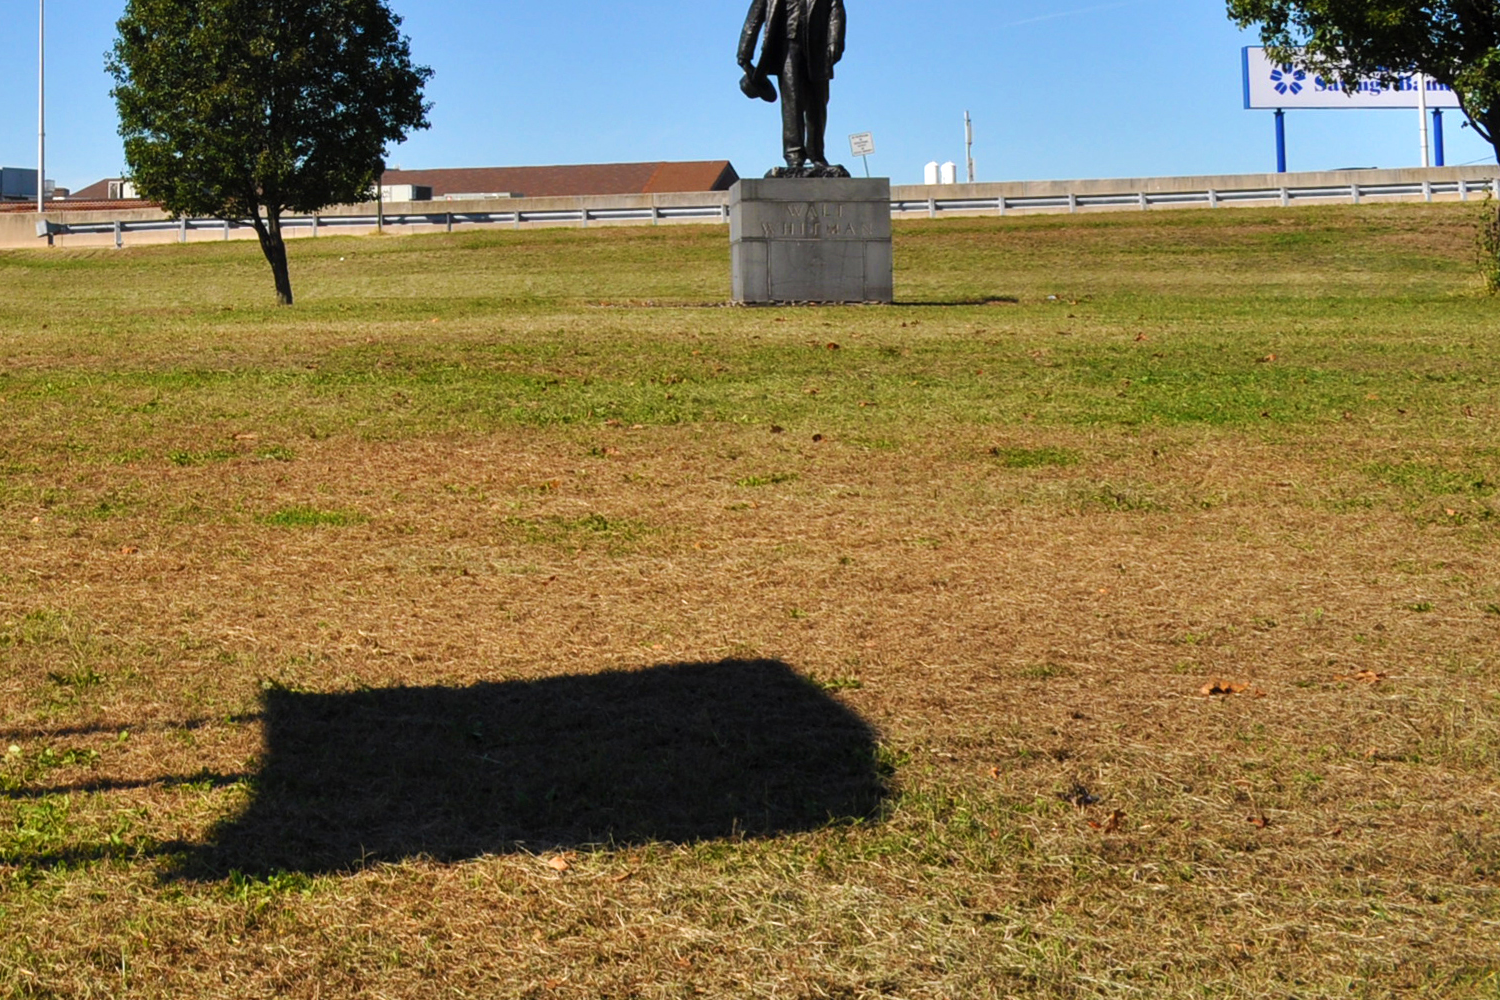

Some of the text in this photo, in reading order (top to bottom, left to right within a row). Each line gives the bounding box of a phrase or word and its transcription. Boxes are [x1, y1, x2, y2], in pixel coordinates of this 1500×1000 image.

[1314, 74, 1390, 96] Sang
[786, 202, 845, 218] WALT
[761, 221, 874, 238] WHITMAN
